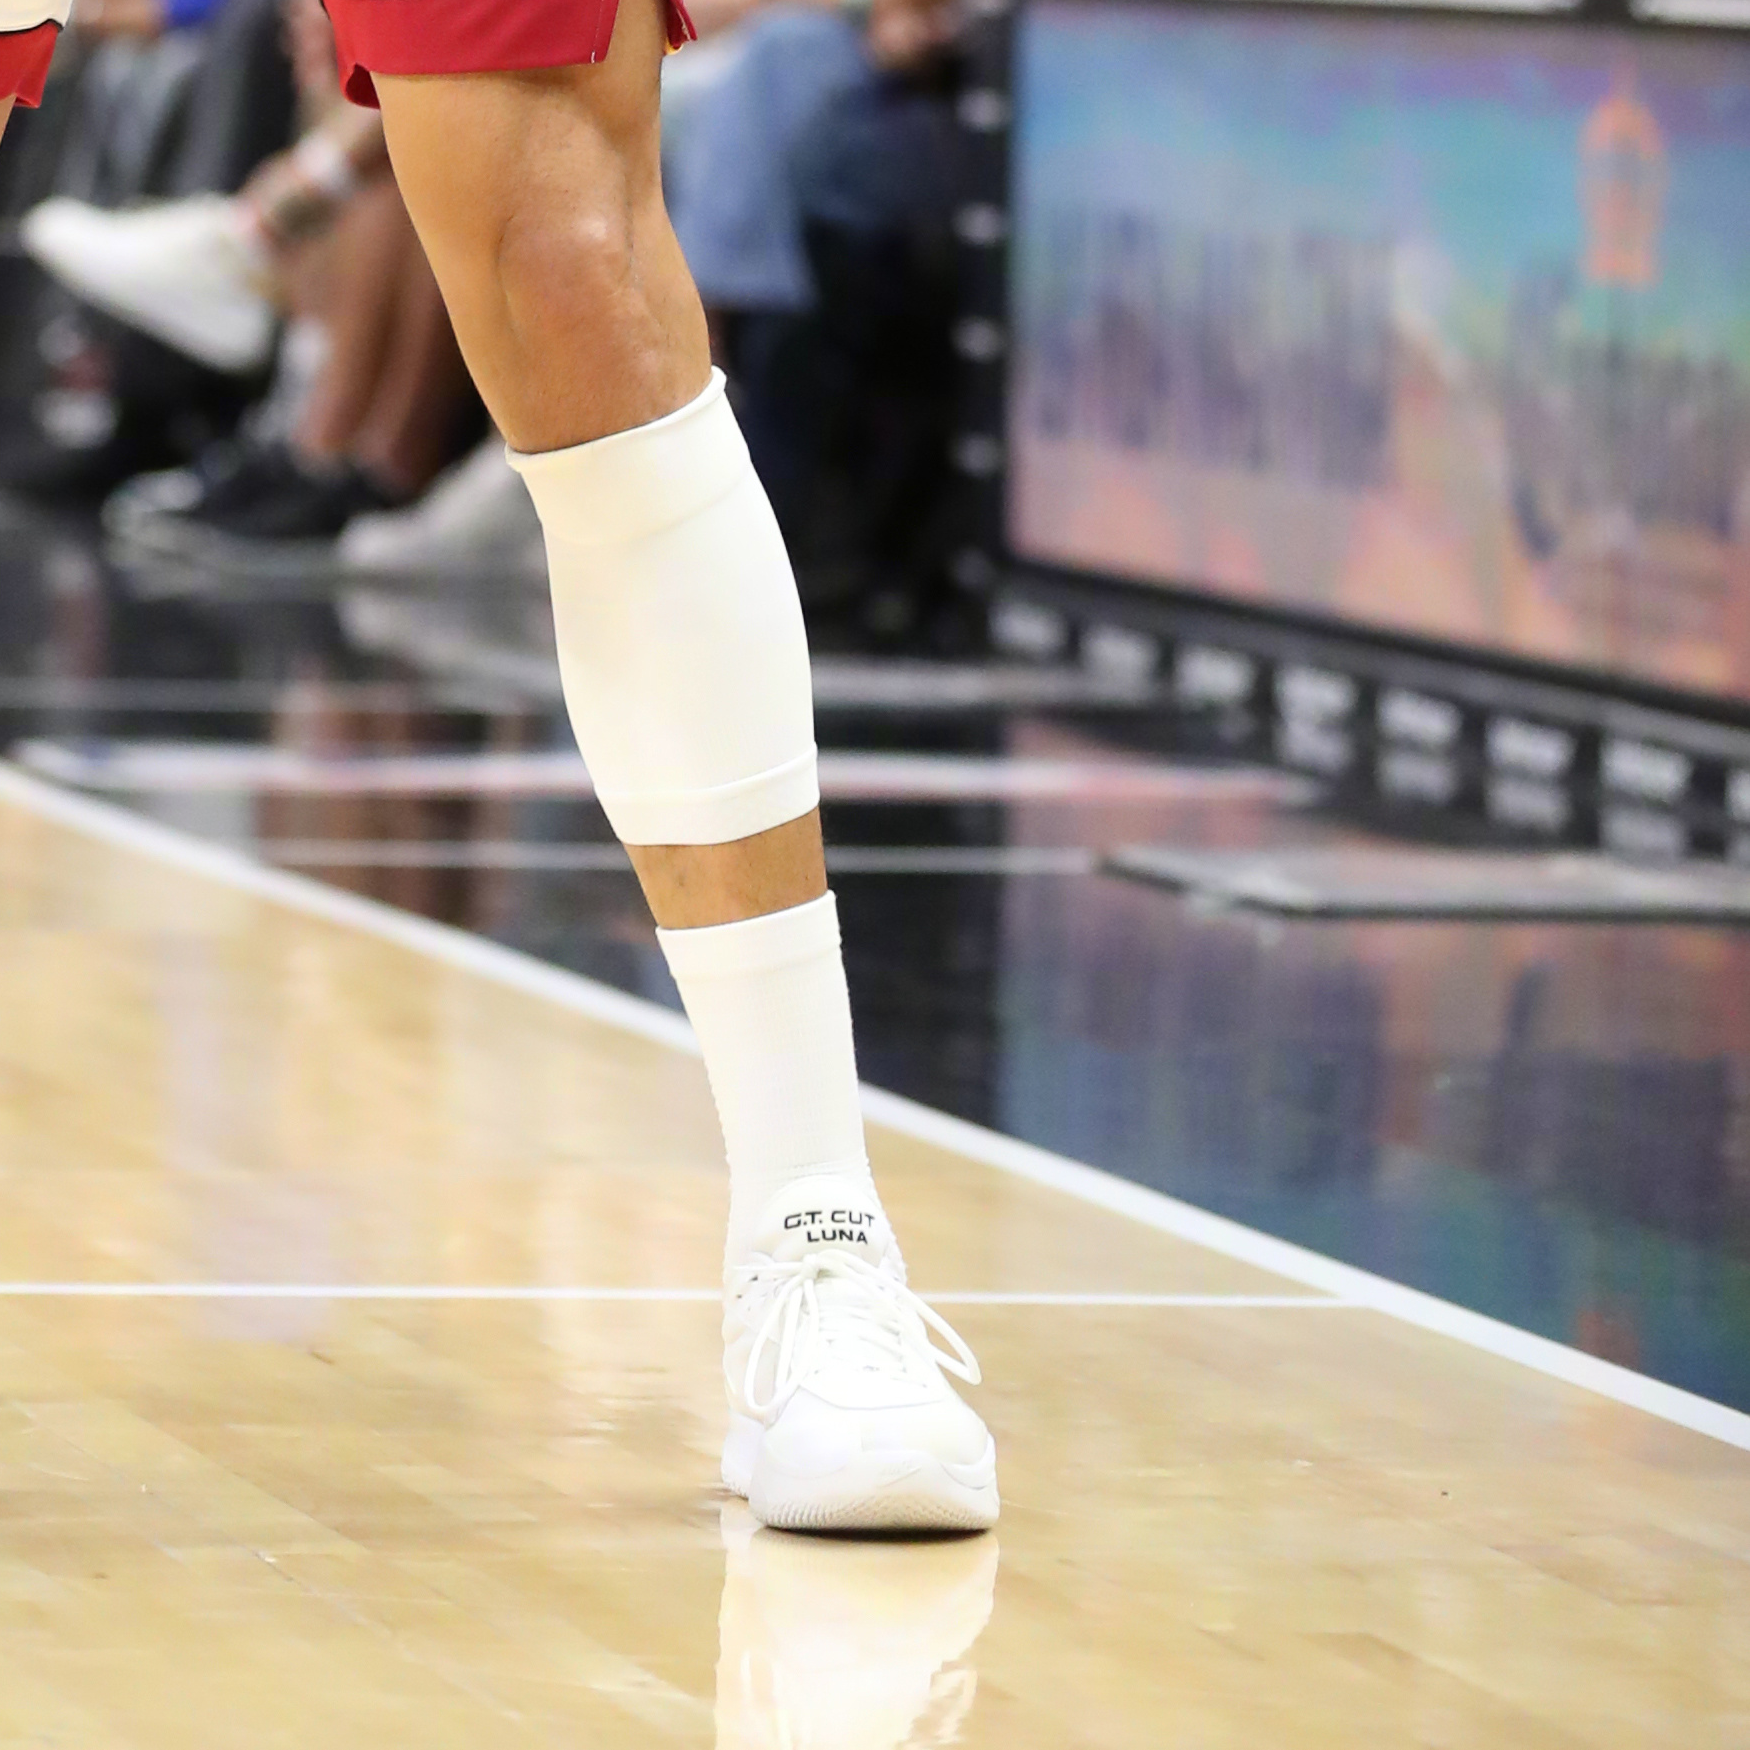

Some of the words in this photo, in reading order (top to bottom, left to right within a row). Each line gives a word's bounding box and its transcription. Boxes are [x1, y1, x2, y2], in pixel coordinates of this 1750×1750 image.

[784, 1211, 823, 1230] G.T.
[831, 1209, 875, 1228] CUT
[807, 1229, 869, 1245] LUNA
